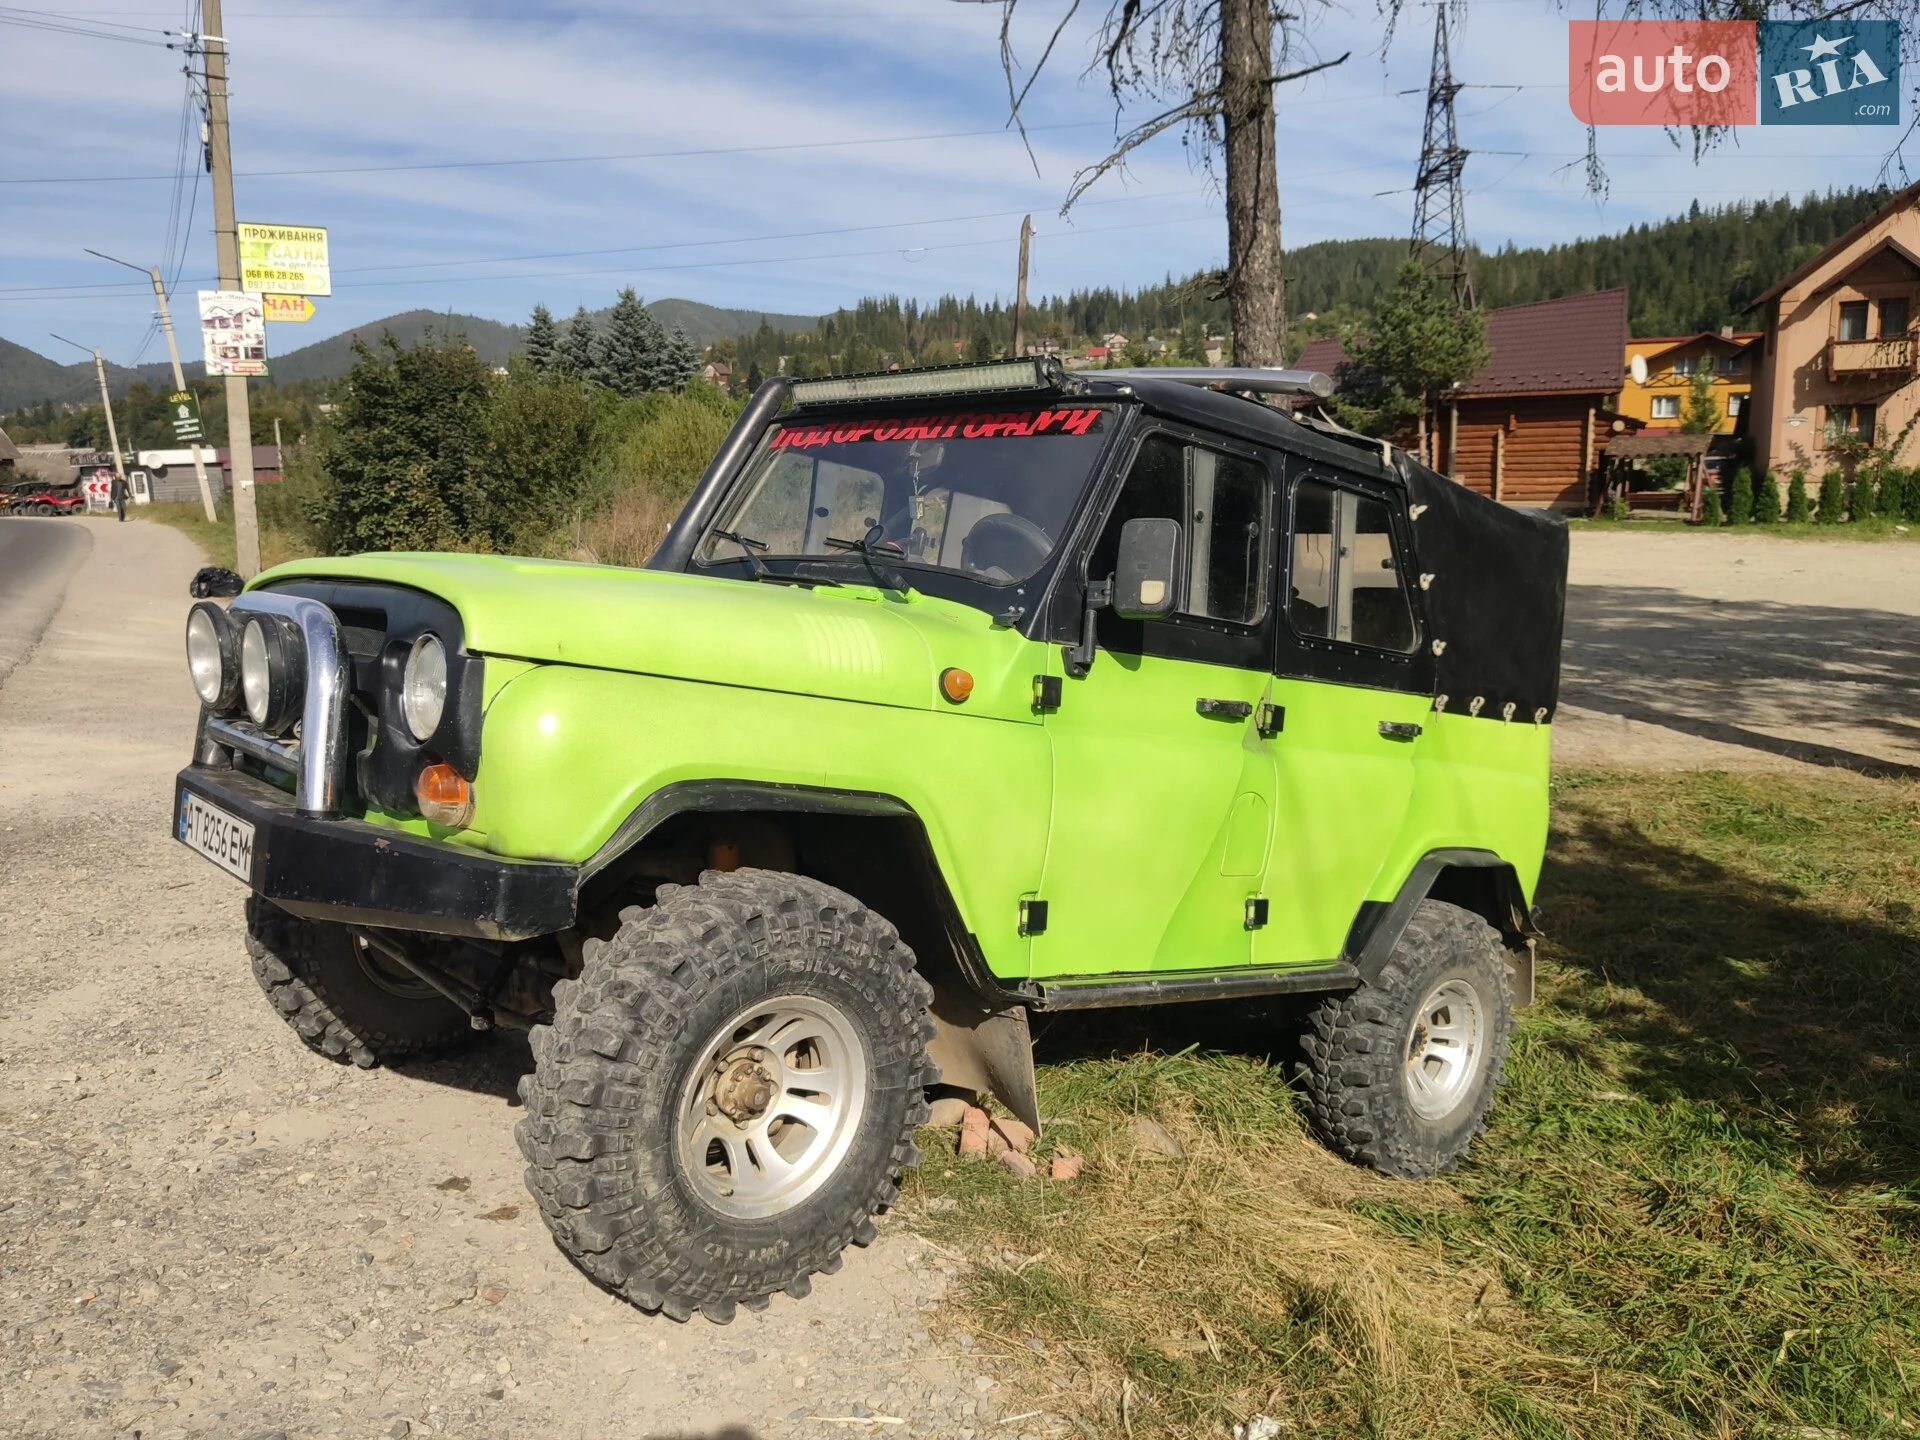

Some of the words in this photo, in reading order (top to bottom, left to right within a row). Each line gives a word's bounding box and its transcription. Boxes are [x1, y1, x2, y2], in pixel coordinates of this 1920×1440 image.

[244, 227, 324, 243] ПРОЖИВАННЯ
[272, 243, 325, 261] САУНА
[246, 269, 262, 279] 068
[264, 270, 275, 279] 86
[277, 271, 287, 280] 28
[289, 272, 305, 281] 265
[266, 298, 305, 311] ЧАН
[187, 802, 202, 842] AT
[203, 811, 229, 859] 8256
[229, 826, 250, 872] EM
